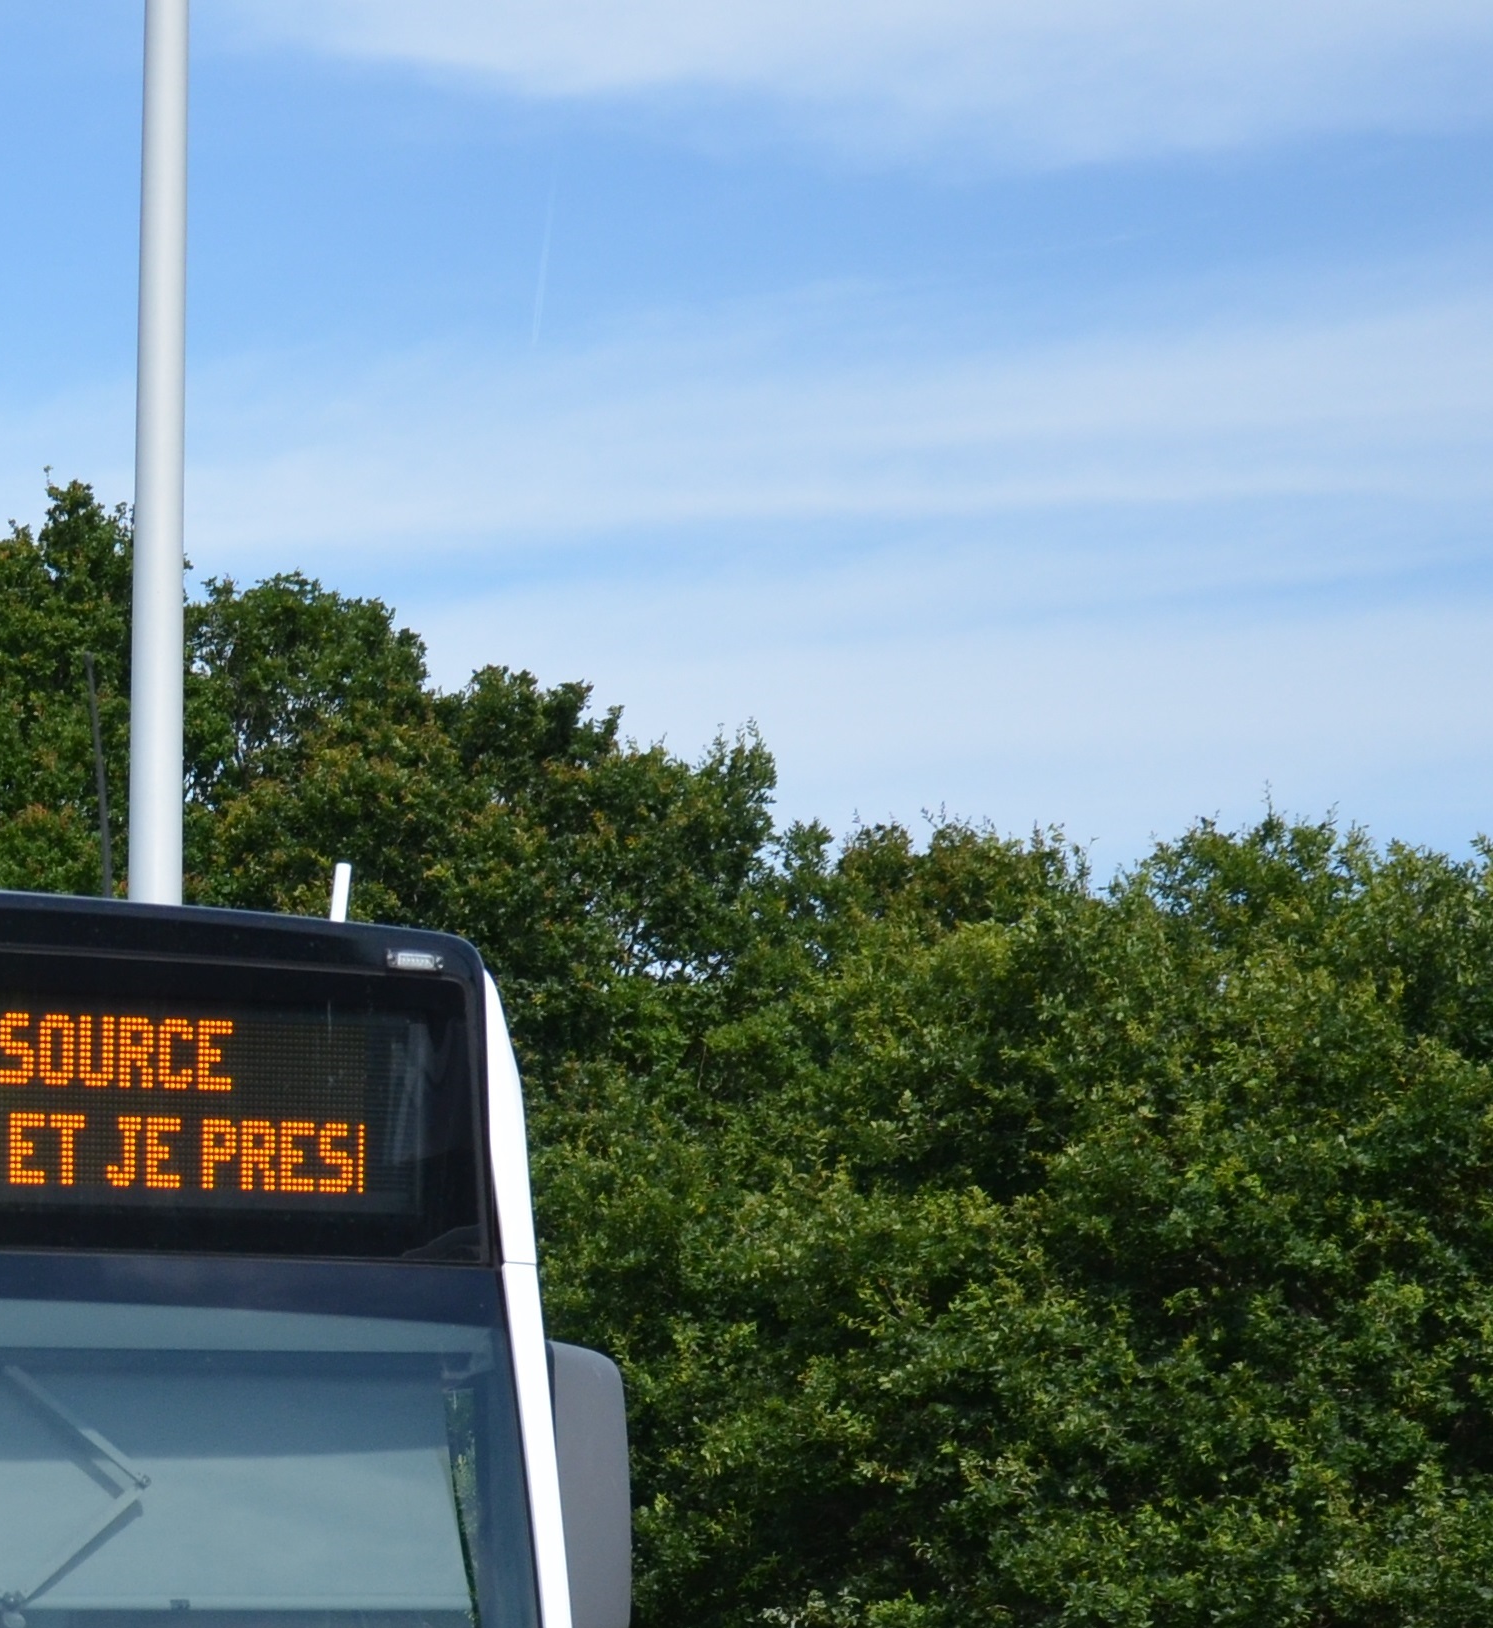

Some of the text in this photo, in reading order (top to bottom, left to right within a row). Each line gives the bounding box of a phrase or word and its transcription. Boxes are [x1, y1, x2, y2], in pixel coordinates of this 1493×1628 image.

[9, 1111, 86, 1185] ET
[106, 1116, 182, 1188] JE
[201, 1118, 365, 1194] PRES
